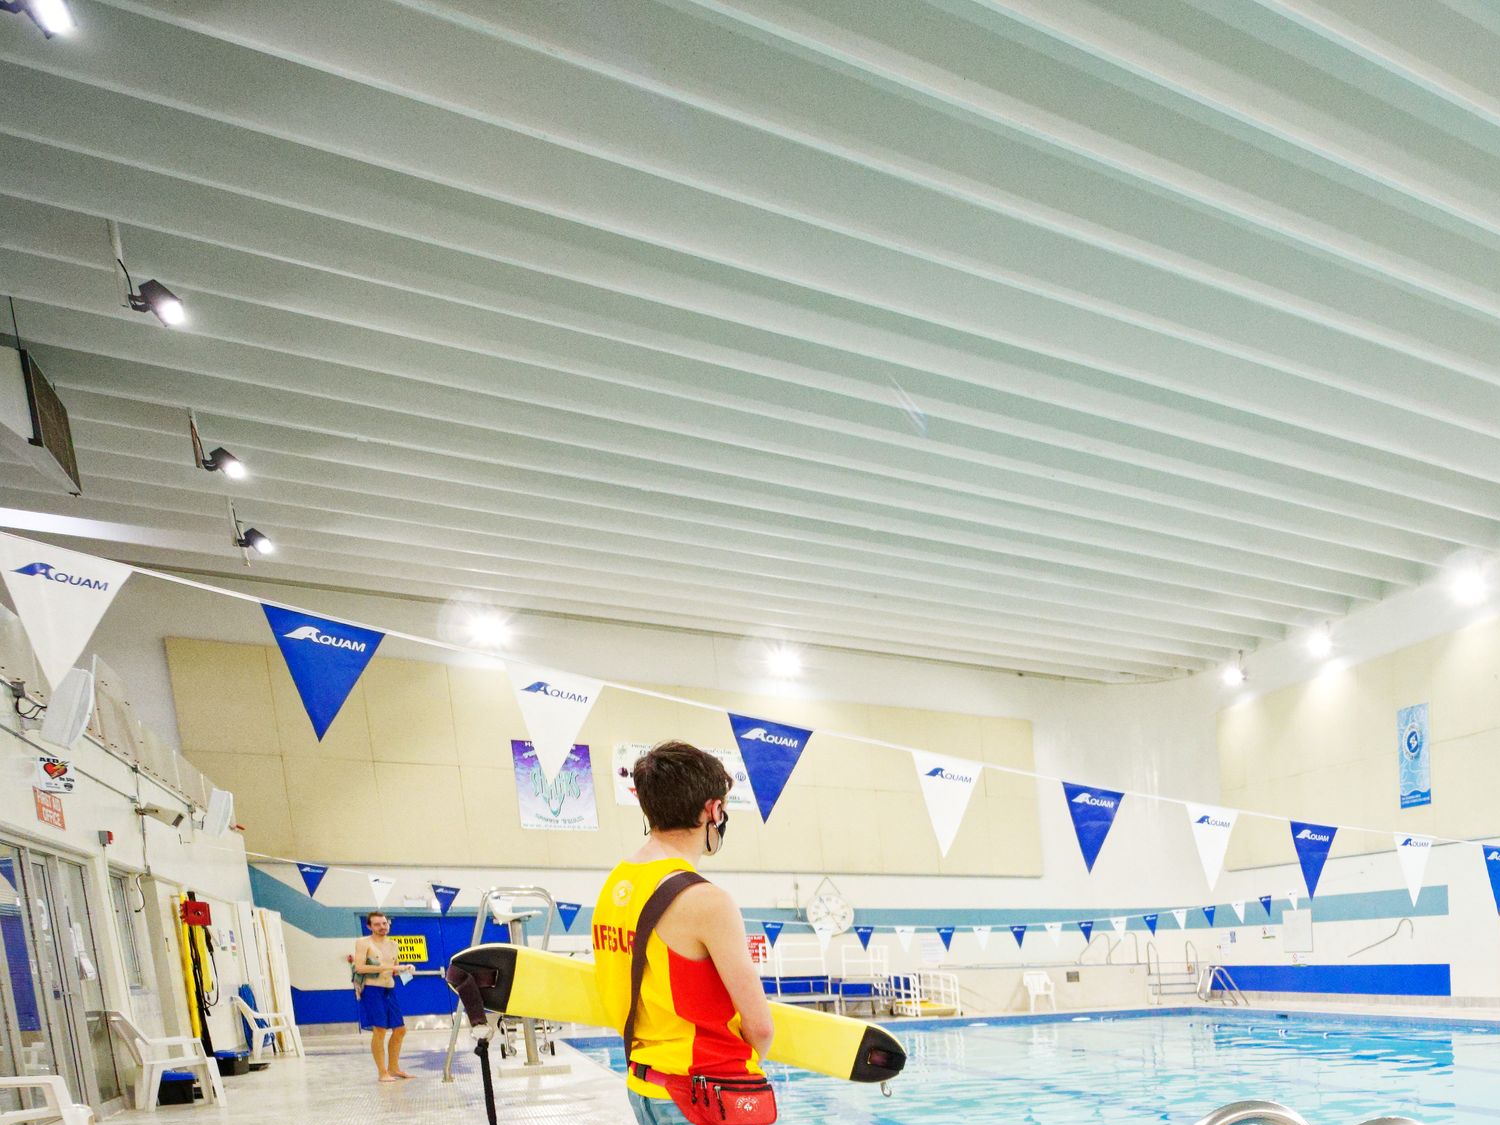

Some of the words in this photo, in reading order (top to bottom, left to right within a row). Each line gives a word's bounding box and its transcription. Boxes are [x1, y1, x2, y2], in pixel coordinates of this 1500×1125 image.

[8, 562, 109, 592] AQUAM
[283, 626, 366, 653] AQUAM
[520, 681, 588, 704] AQUAM
[740, 727, 799, 748] AQUAM
[924, 767, 972, 784] AQUAM
[1071, 792, 1115, 809] AQUAM
[1195, 815, 1231, 828] AQUAM
[1296, 829, 1330, 842] AQUAM
